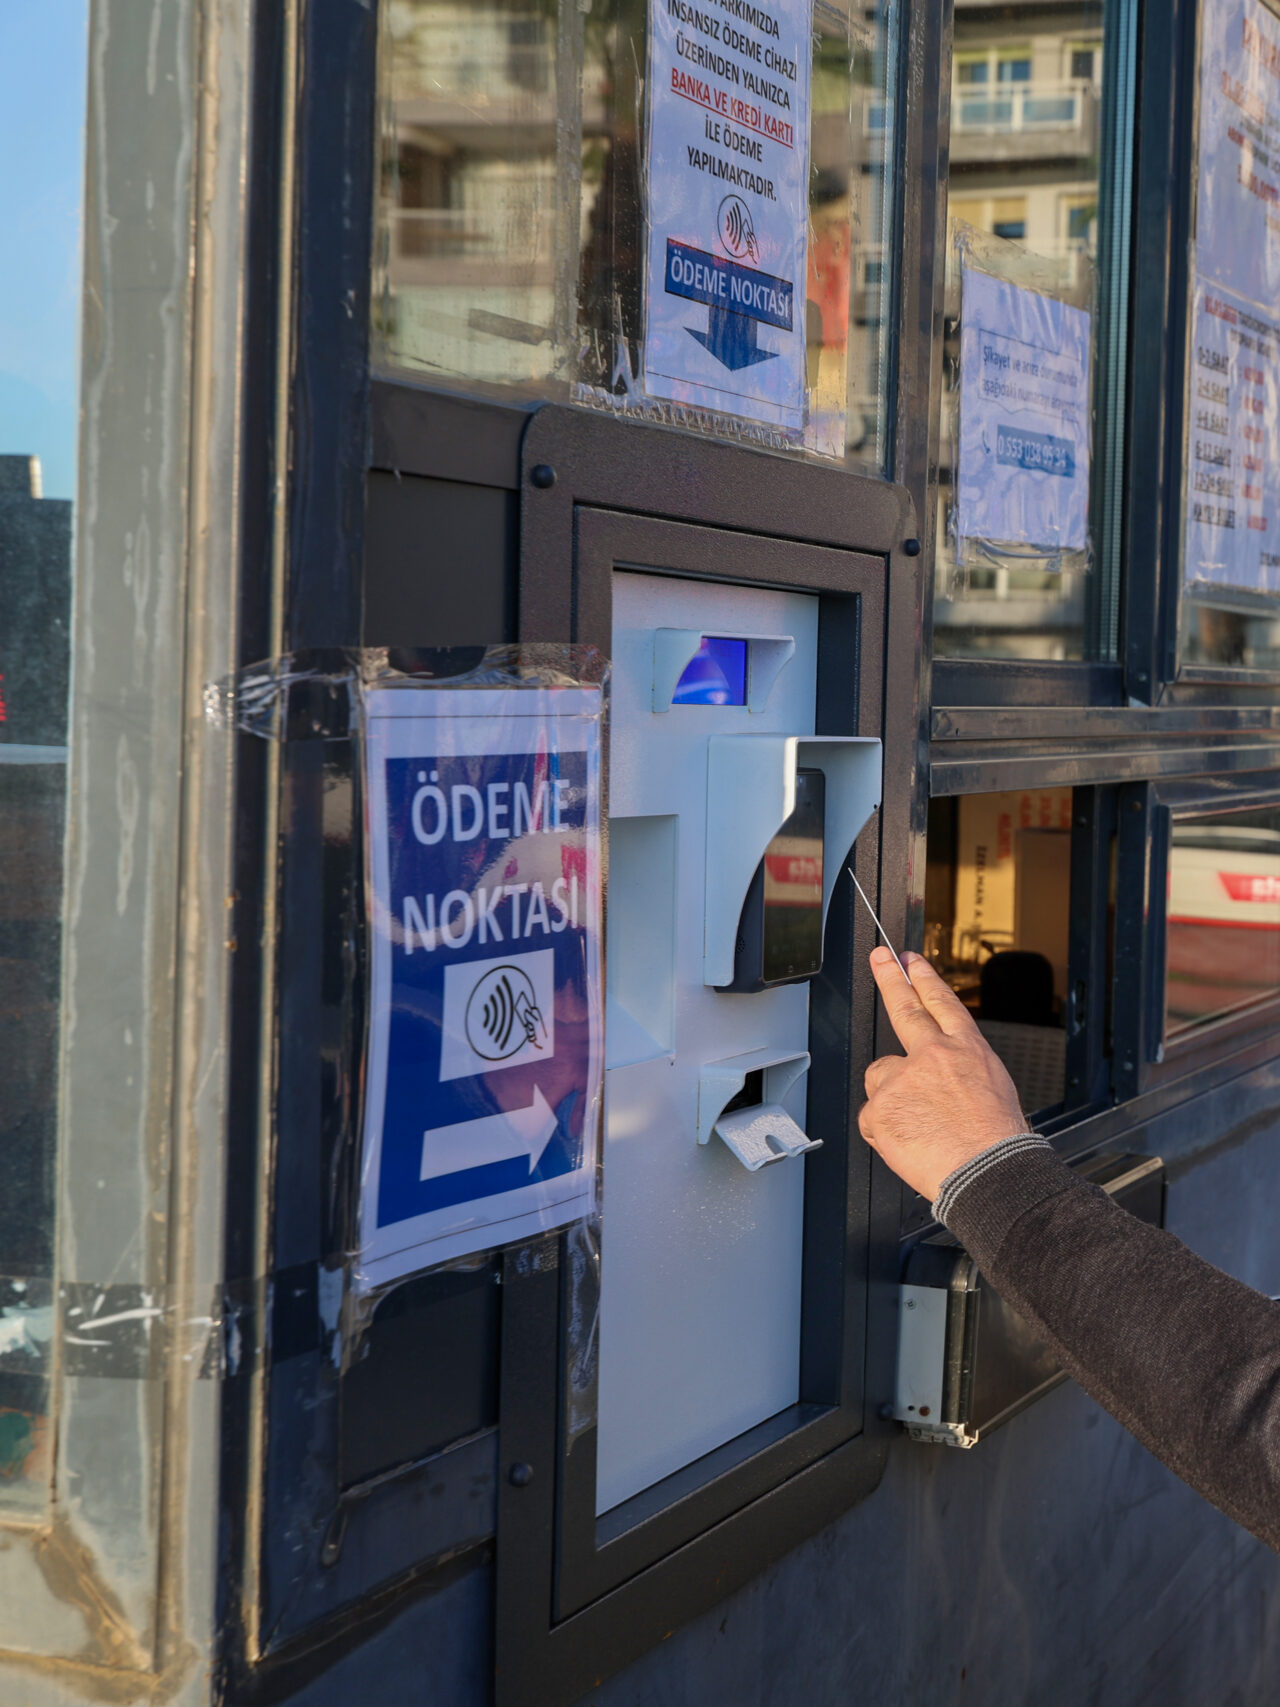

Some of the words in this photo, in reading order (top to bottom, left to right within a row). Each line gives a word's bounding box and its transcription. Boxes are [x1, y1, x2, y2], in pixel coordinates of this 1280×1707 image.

[676, 30, 739, 85] ÜZERİNDEN
[742, 69, 790, 110] YALNIZCA
[722, 21, 762, 64] ÖDEME
[764, 46, 797, 82] CİHAZI
[671, 67, 711, 105] BANKA
[713, 88, 728, 112] VE
[731, 97, 762, 129] KREDİ
[764, 114, 794, 144] KARTI
[705, 114, 720, 143] İLE
[723, 123, 763, 163] ÖDEME
[687, 145, 777, 201] YAPILMAKTADIR.
[671, 249, 727, 298] ÖDEME
[731, 276, 789, 318] NOKTASI
[998, 434, 1004, 456] 0
[410, 770, 571, 846] ÖDEME
[403, 875, 579, 955] NOKTASI
